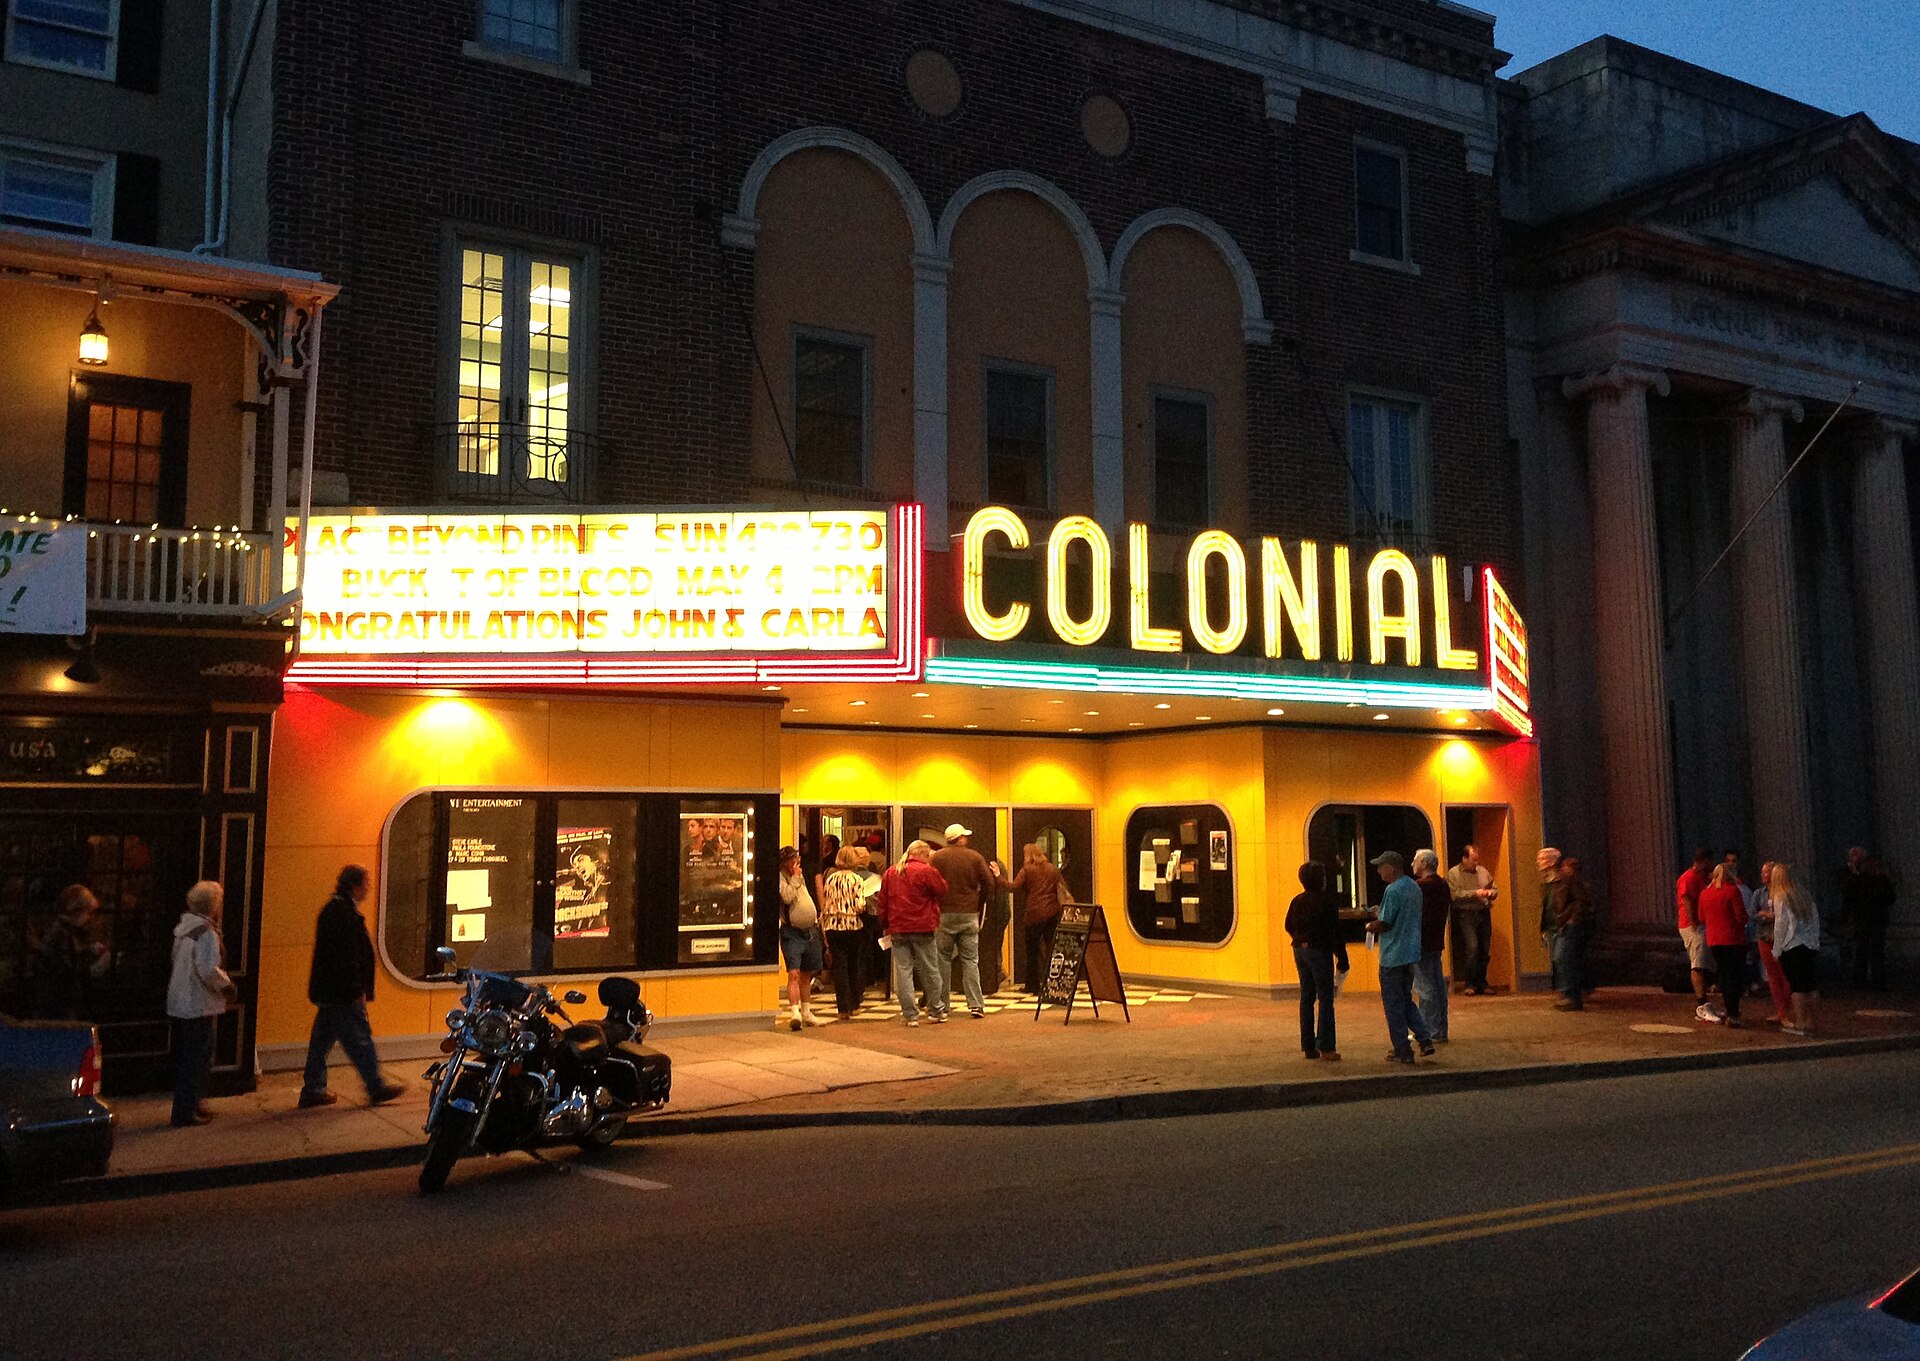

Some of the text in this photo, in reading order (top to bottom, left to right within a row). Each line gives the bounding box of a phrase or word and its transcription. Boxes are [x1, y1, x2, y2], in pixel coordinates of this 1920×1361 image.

[388, 524, 526, 554] BEYOND
[655, 523, 728, 553] SUN
[485, 567, 529, 597] OF
[677, 565, 749, 596] MAY
[765, 564, 783, 595] 4
[962, 505, 1479, 671] COLONIAL
[300, 608, 885, 641] ONGRATULATIONS JOHN & CARLA
